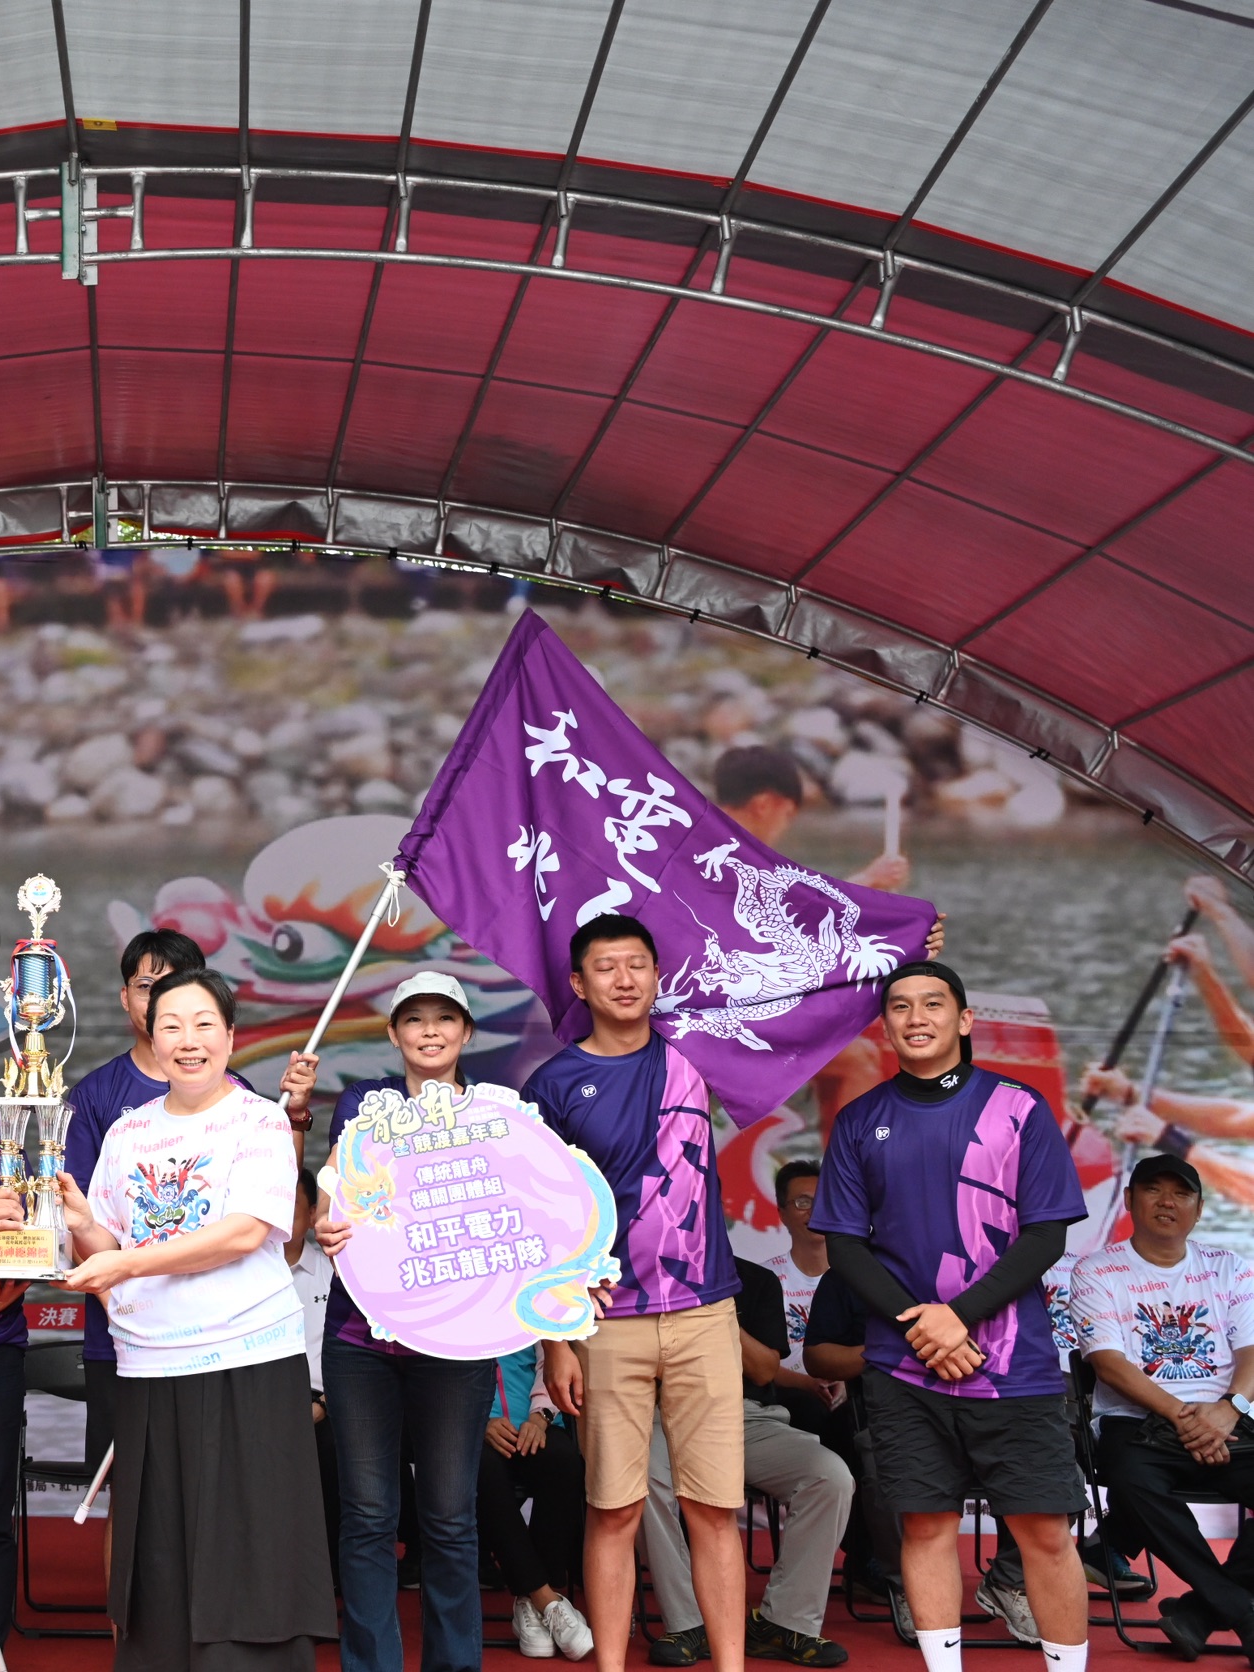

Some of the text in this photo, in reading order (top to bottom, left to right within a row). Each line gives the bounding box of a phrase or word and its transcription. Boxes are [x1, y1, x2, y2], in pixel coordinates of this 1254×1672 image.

[479, 1085, 517, 1102] 2025
[132, 1135, 184, 1154] Hualien
[413, 1118, 508, 1154] 競渡嘉年華
[416, 1156, 488, 1186] 傳統龍舟
[411, 1177, 504, 1210] 機關團體組
[408, 1207, 522, 1252] 和平電力
[400, 1237, 547, 1289] 兆瓦龍舟隊
[1127, 1280, 1169, 1294] Hualien
[38, 1307, 78, 1327] 決賽
[117, 1298, 154, 1316] Hualien
[243, 1324, 287, 1351] Happy
